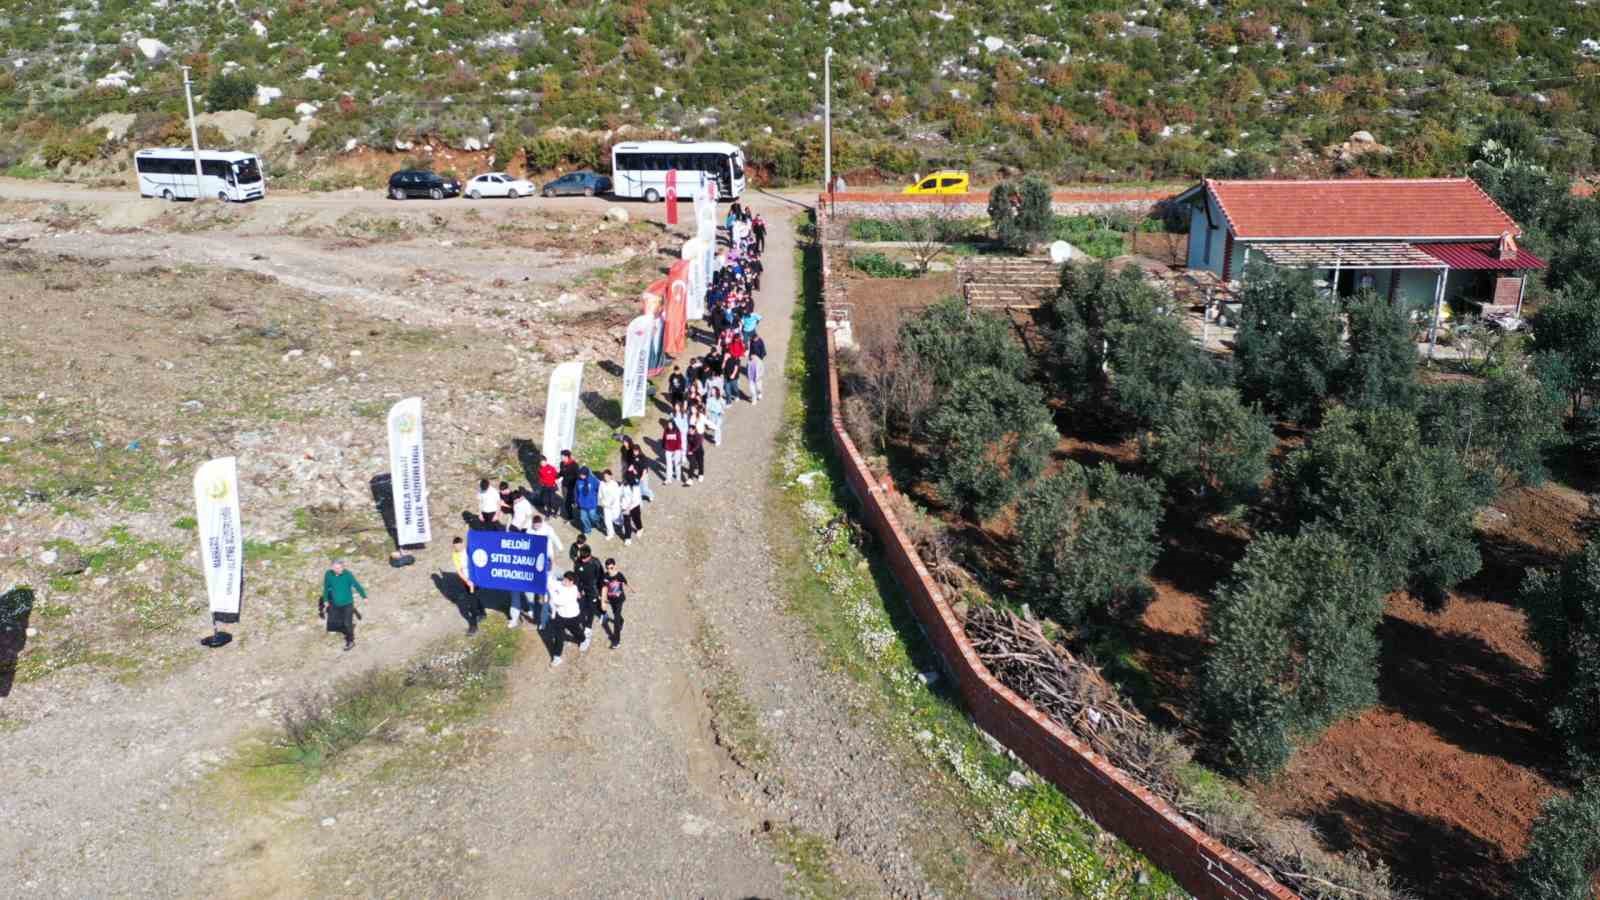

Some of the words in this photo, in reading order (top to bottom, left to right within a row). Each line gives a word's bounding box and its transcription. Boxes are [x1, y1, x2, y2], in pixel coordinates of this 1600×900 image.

[501, 538, 531, 550] BELDİBİ
[491, 553, 511, 563] SITKI
[491, 569, 534, 581] ORTAOKULU
